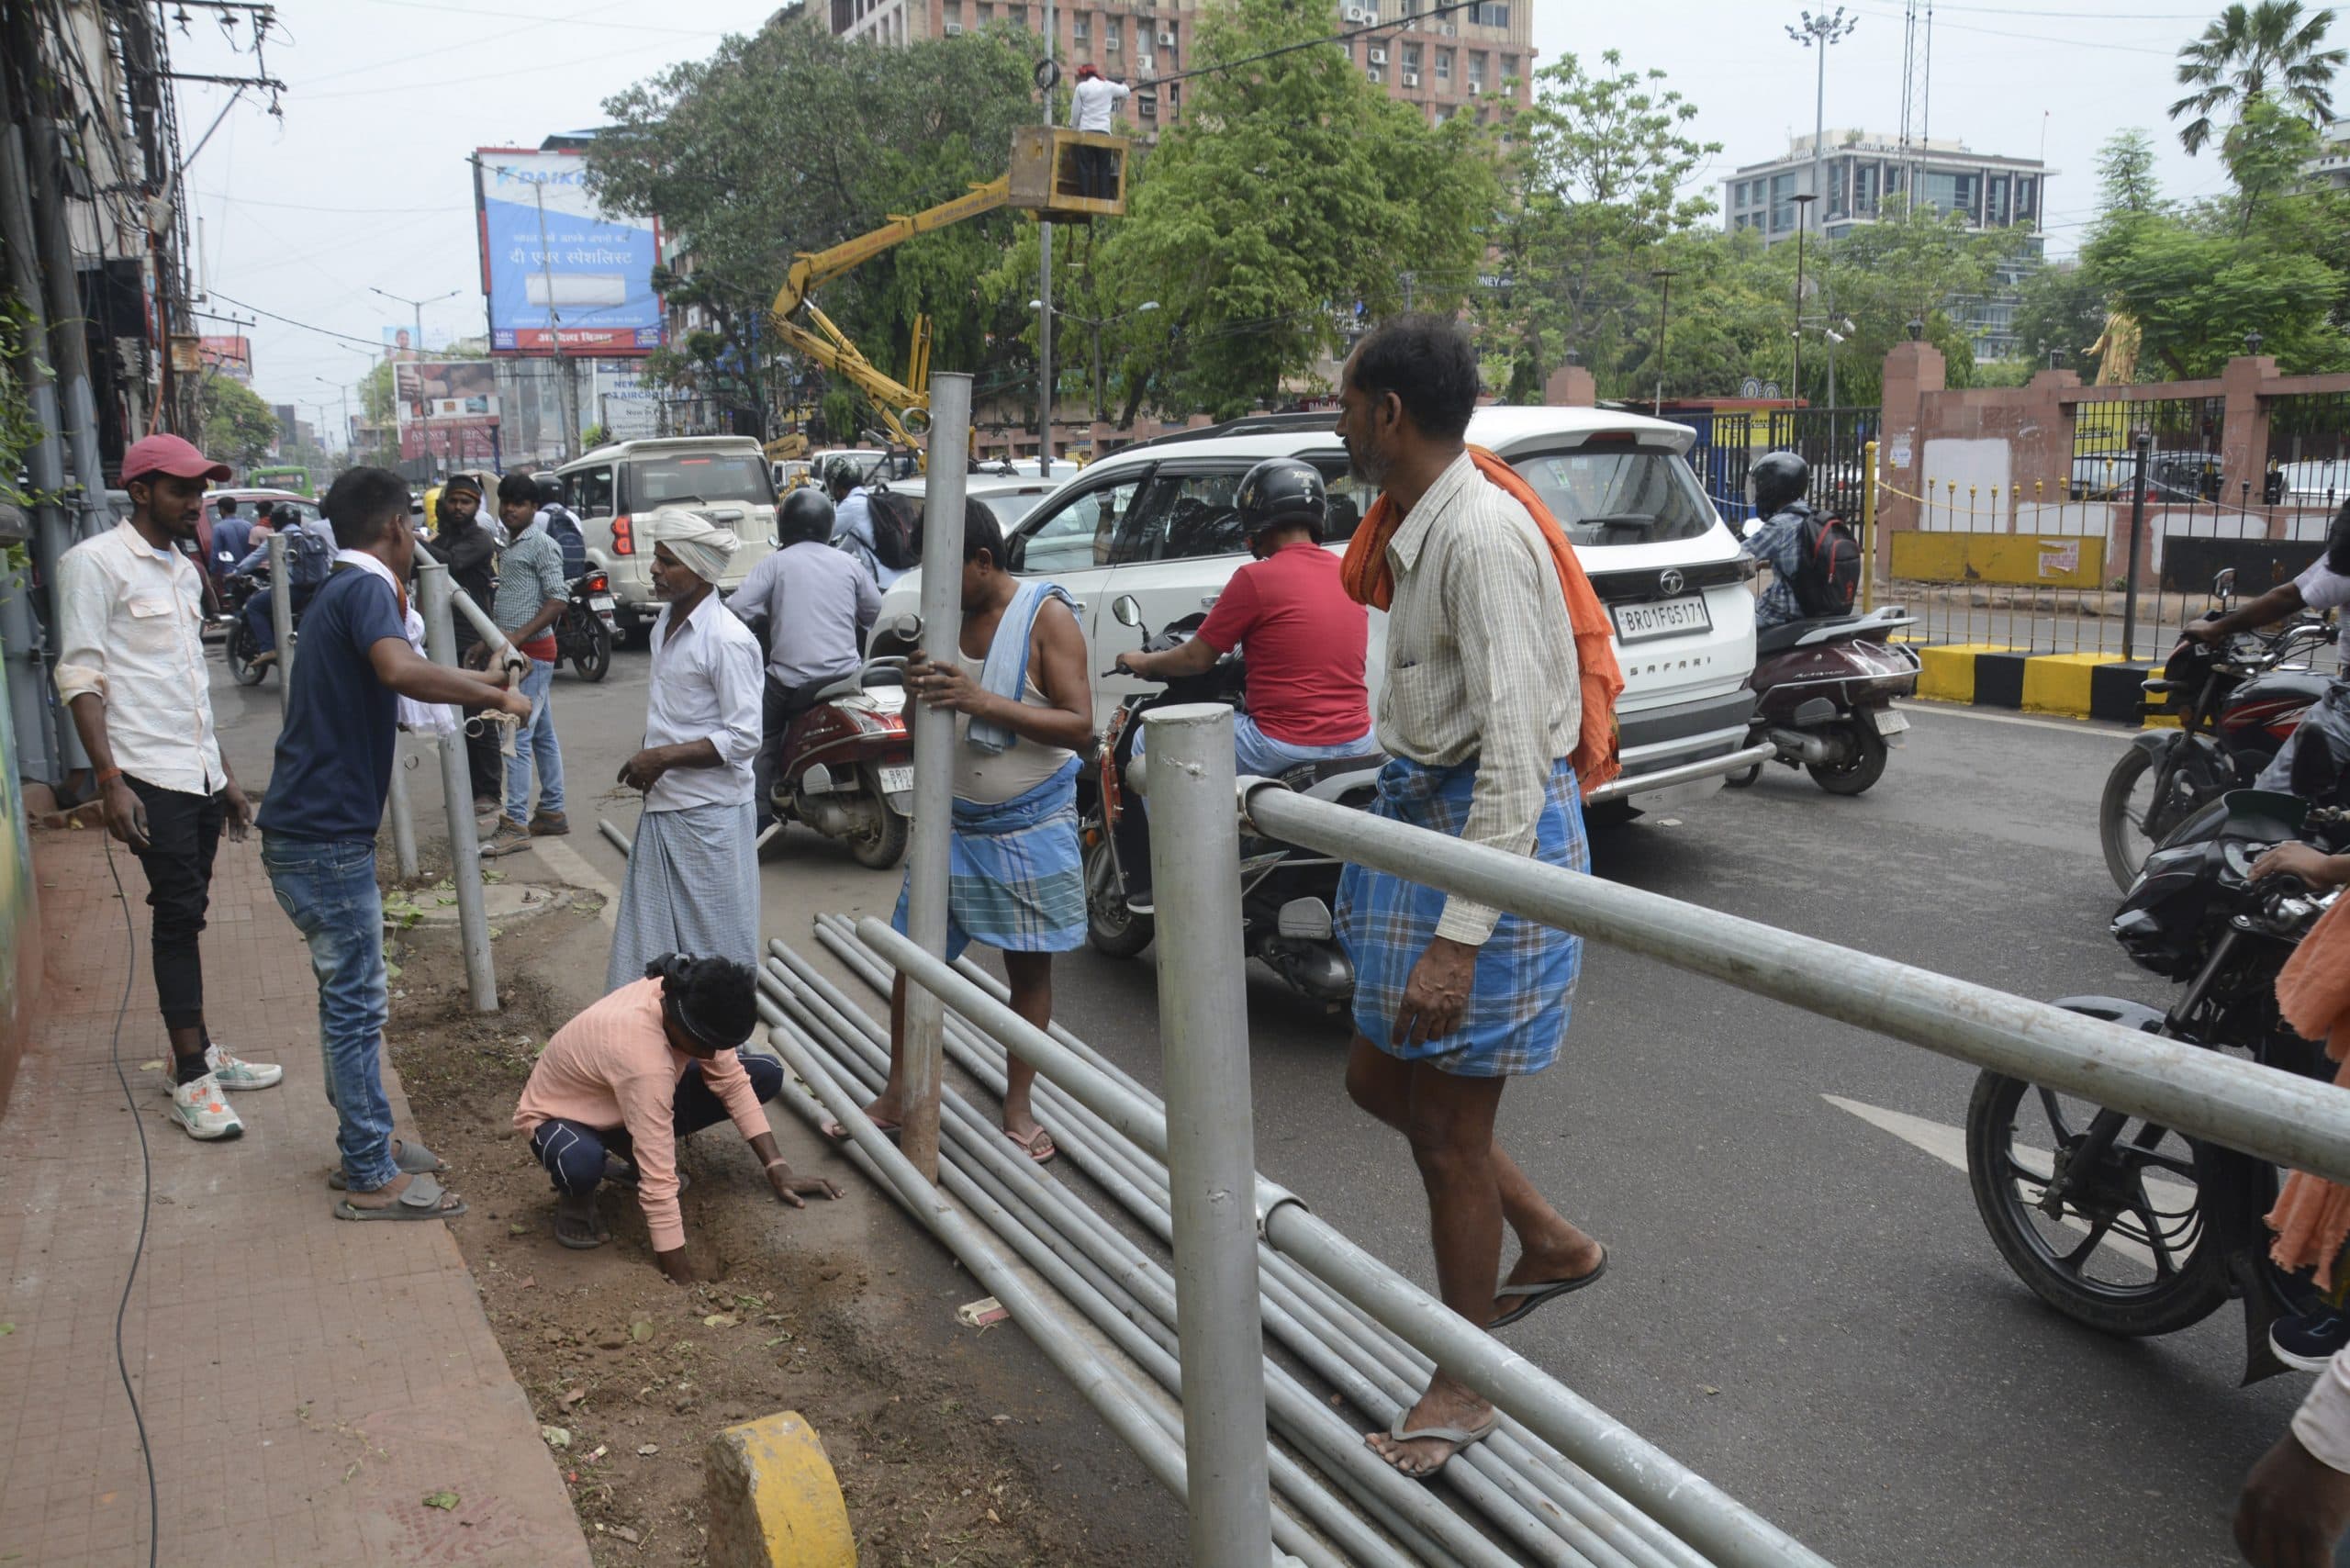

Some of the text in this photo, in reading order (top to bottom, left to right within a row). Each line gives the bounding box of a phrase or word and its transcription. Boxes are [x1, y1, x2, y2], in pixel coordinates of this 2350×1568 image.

[565, 247, 632, 264] स्पेशलिस्ट
[1626, 602, 1706, 631] BR01FG5171
[1629, 655, 1711, 676] SAFARI
